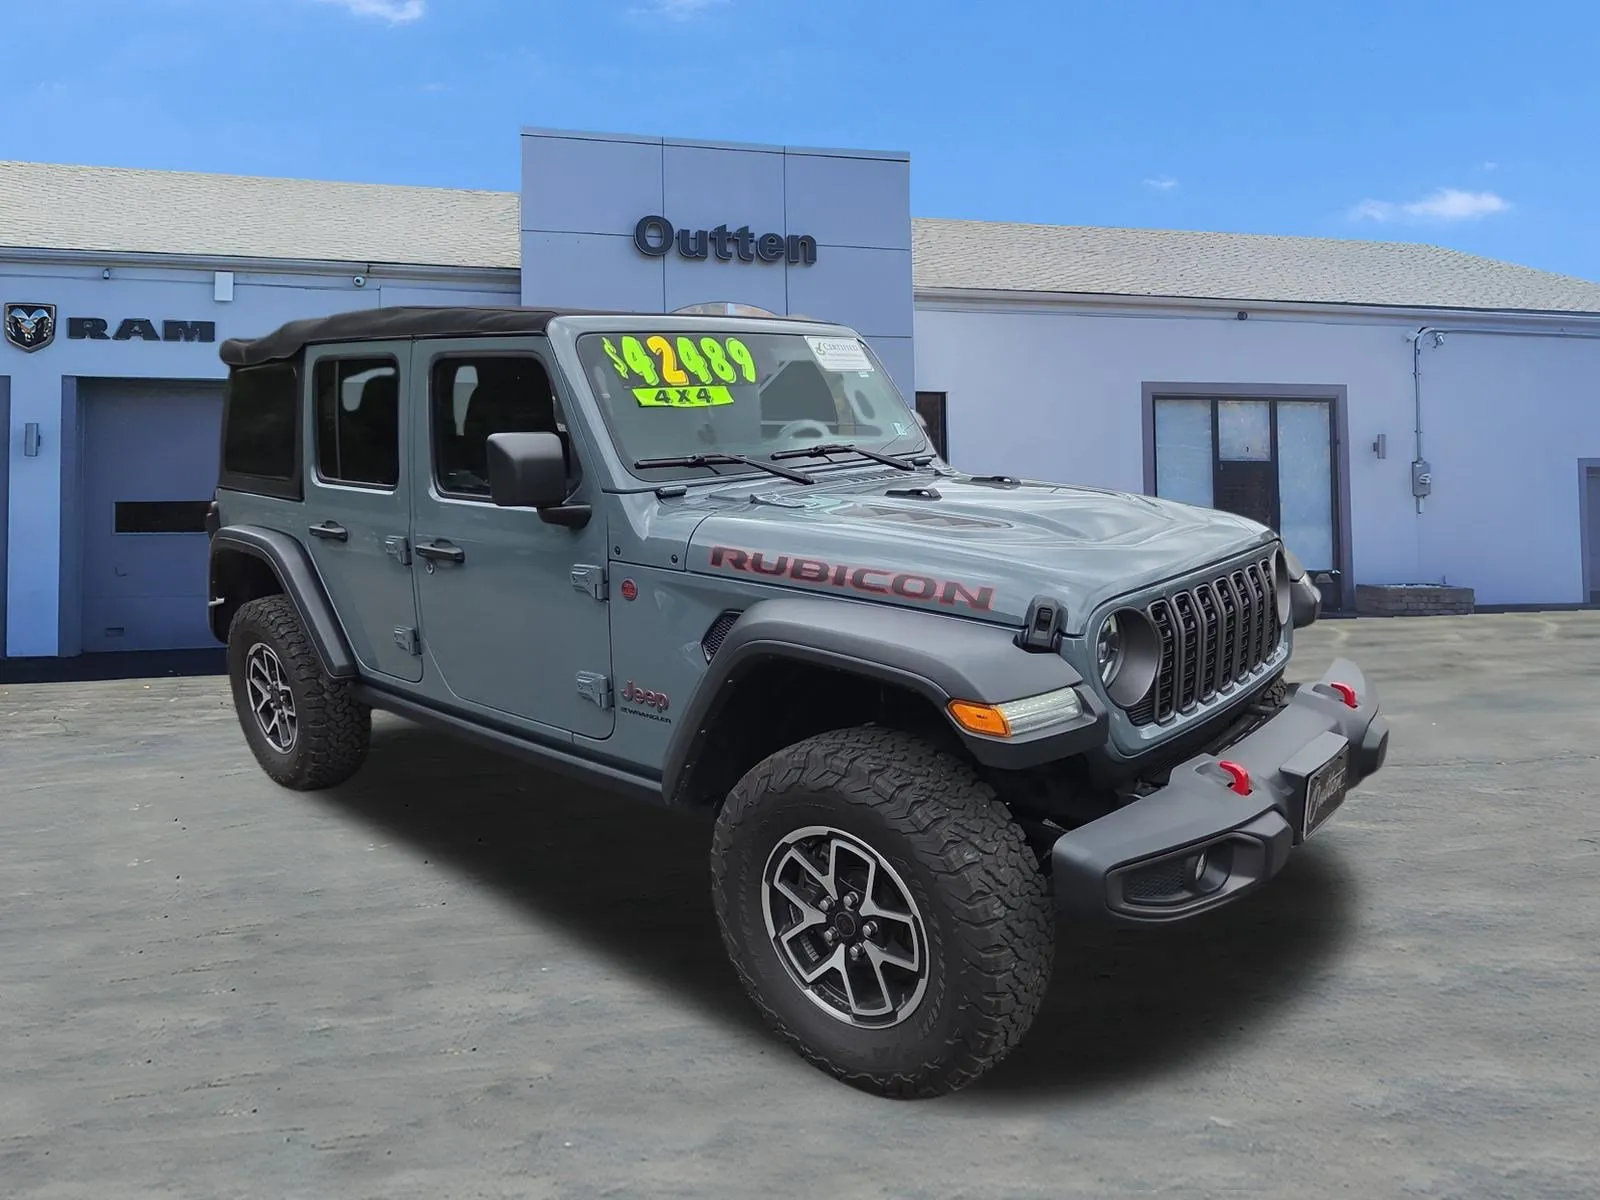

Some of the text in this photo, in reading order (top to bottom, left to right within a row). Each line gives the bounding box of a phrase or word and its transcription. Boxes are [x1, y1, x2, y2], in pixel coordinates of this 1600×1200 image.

[634, 215, 817, 264] Outten
[66, 317, 215, 342] RAM
[602, 335, 756, 386] $42489
[708, 545, 995, 611] RUBICON
[621, 680, 669, 713] Jeep
[626, 708, 672, 724] WRANGLER
